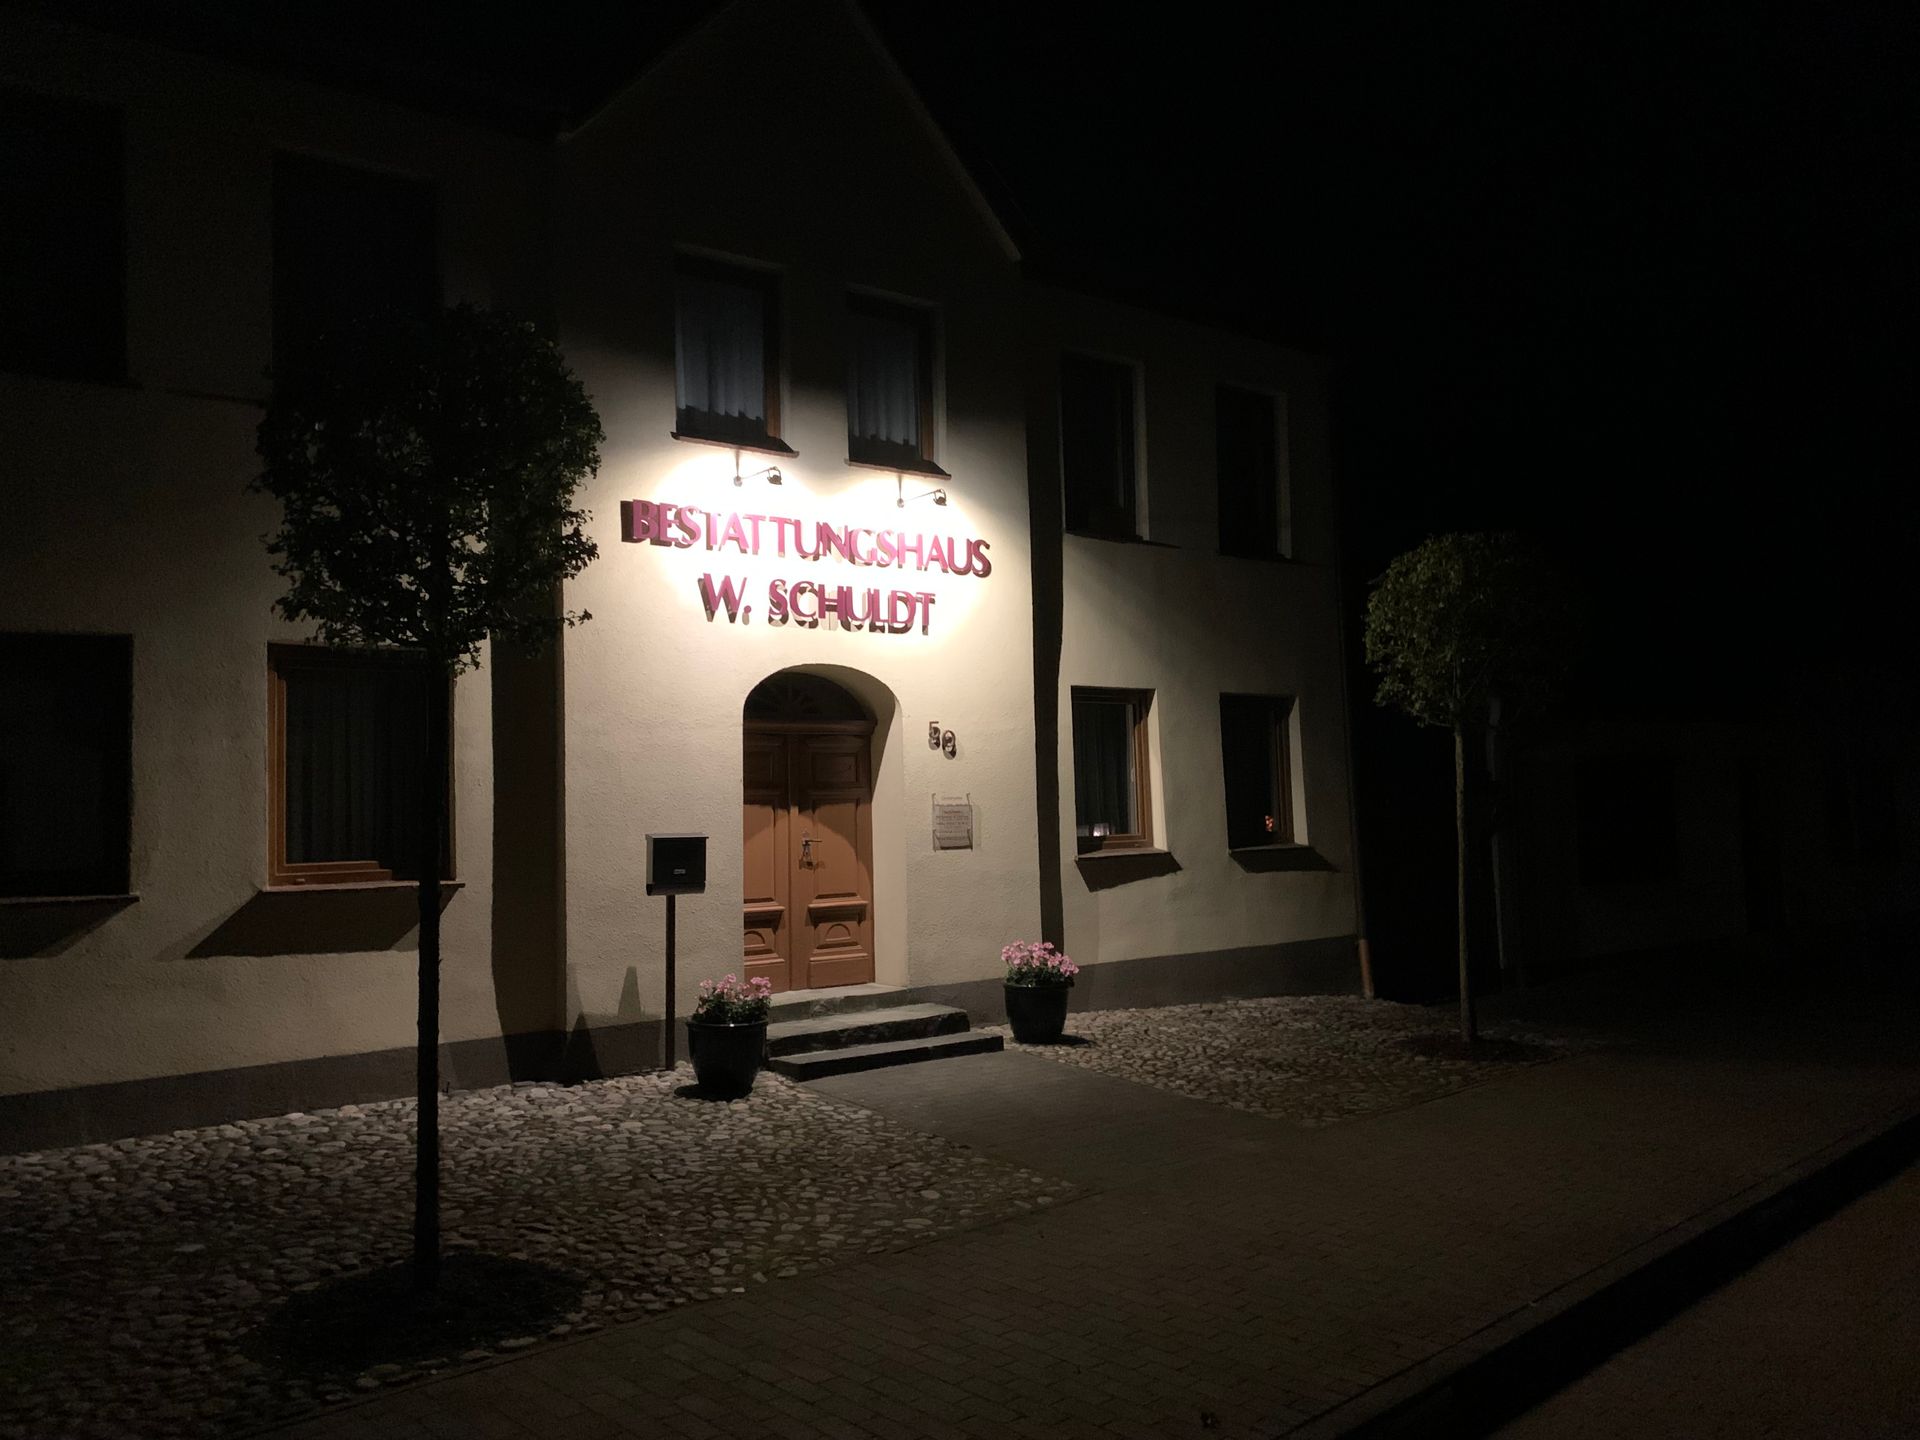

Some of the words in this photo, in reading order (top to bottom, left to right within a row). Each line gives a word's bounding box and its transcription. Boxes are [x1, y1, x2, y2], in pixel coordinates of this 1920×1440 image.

[628, 498, 992, 577] BESTATTUNGSHAUS
[701, 573, 752, 618] W.
[768, 578, 936, 630] SCHULDT
